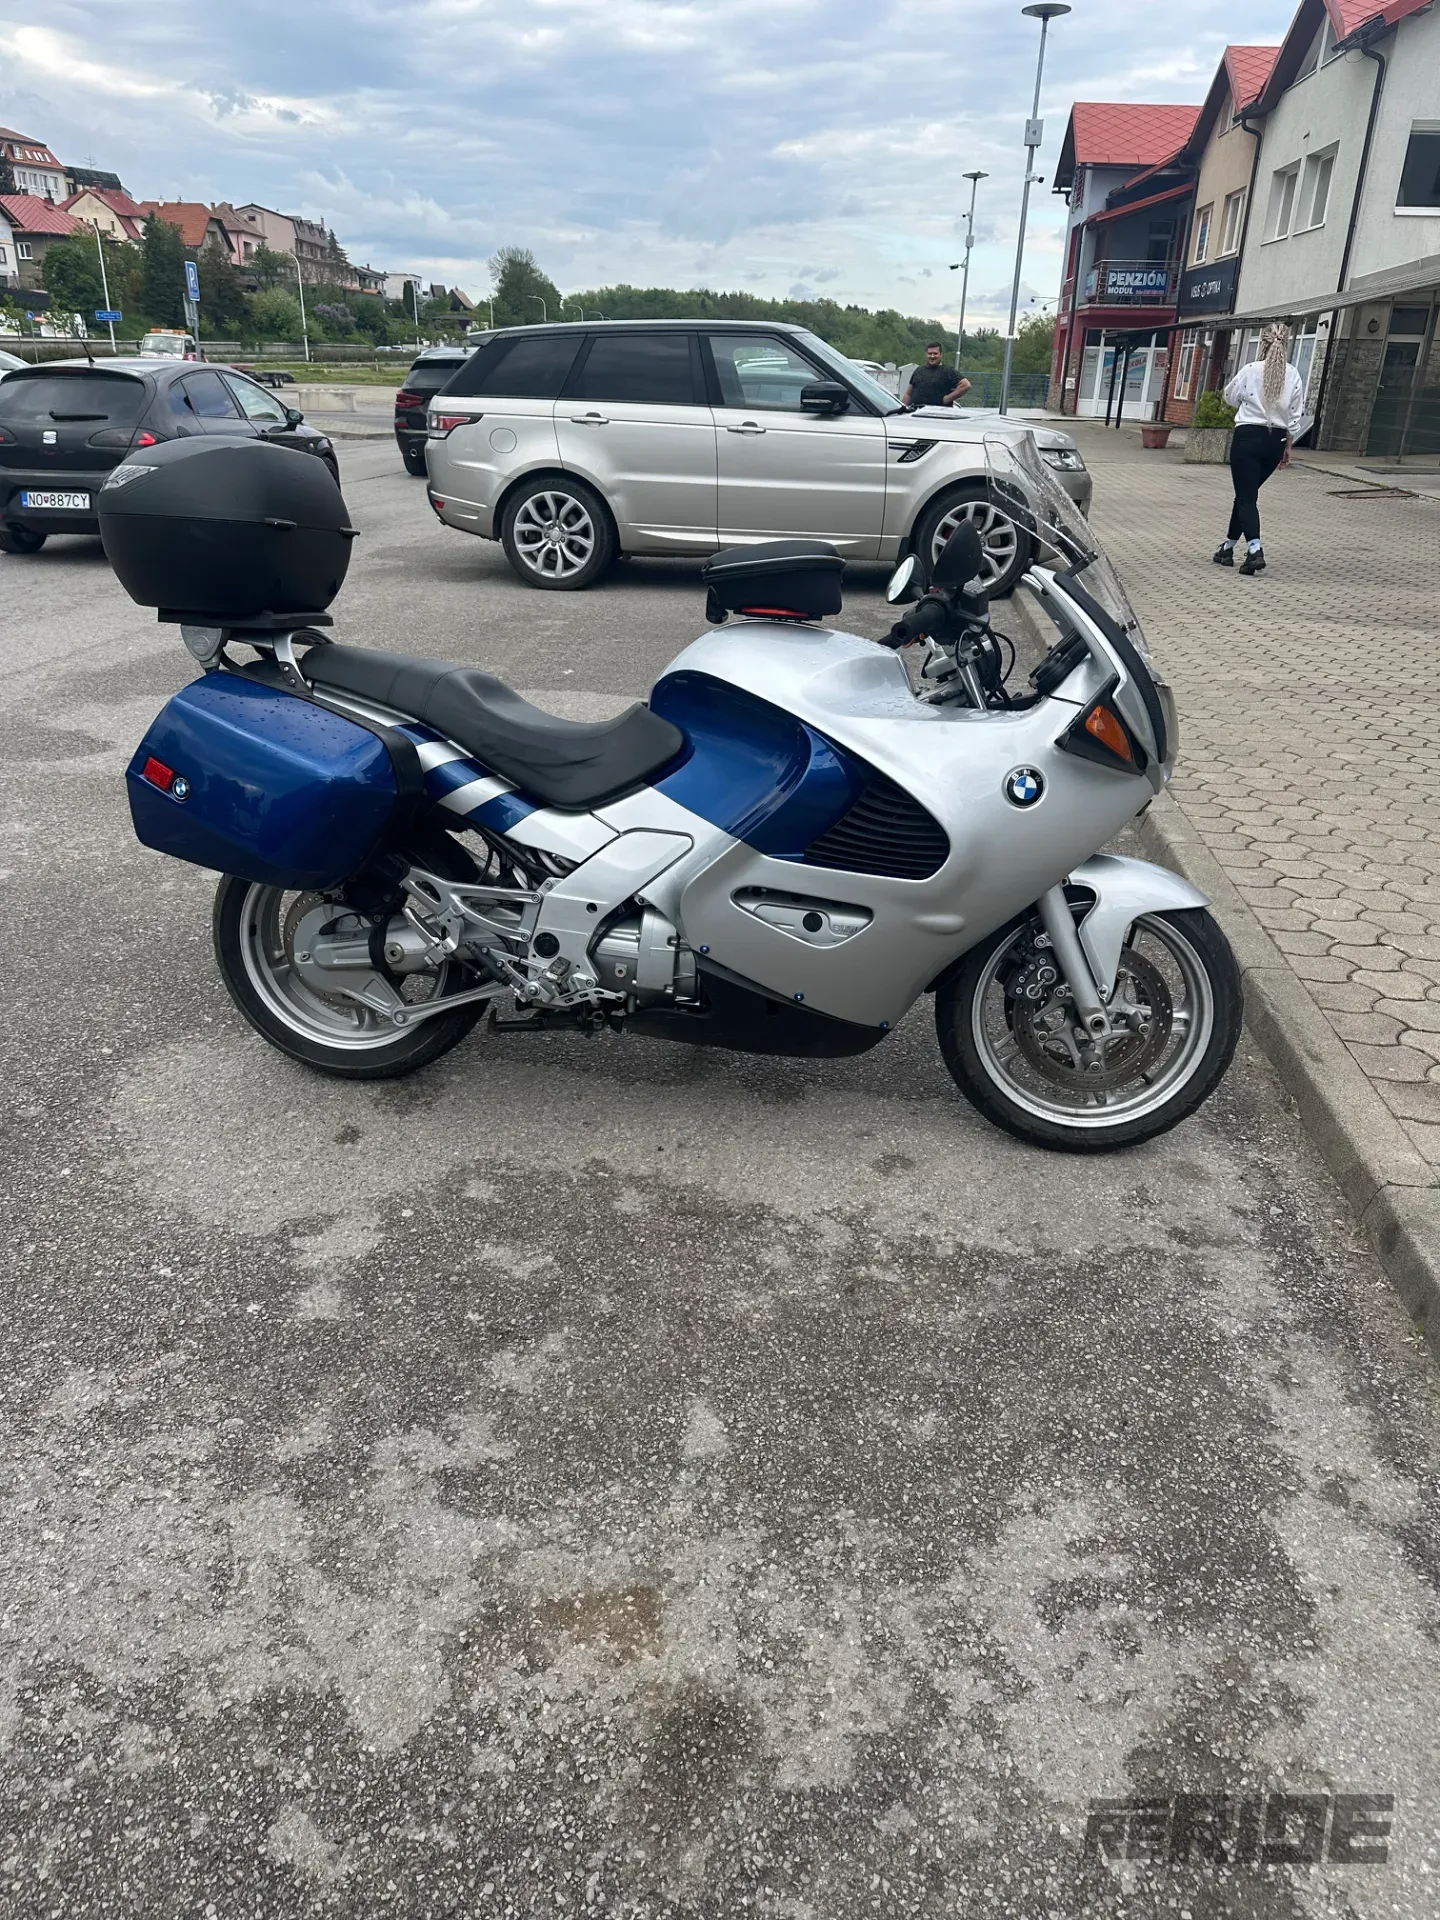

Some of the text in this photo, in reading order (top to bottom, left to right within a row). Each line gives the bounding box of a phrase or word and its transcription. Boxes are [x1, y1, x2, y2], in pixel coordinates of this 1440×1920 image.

[1108, 270, 1166, 286] PENZIÓN
[1107, 286, 1134, 295] MODUL
[1011, 769, 1042, 783] BMW
